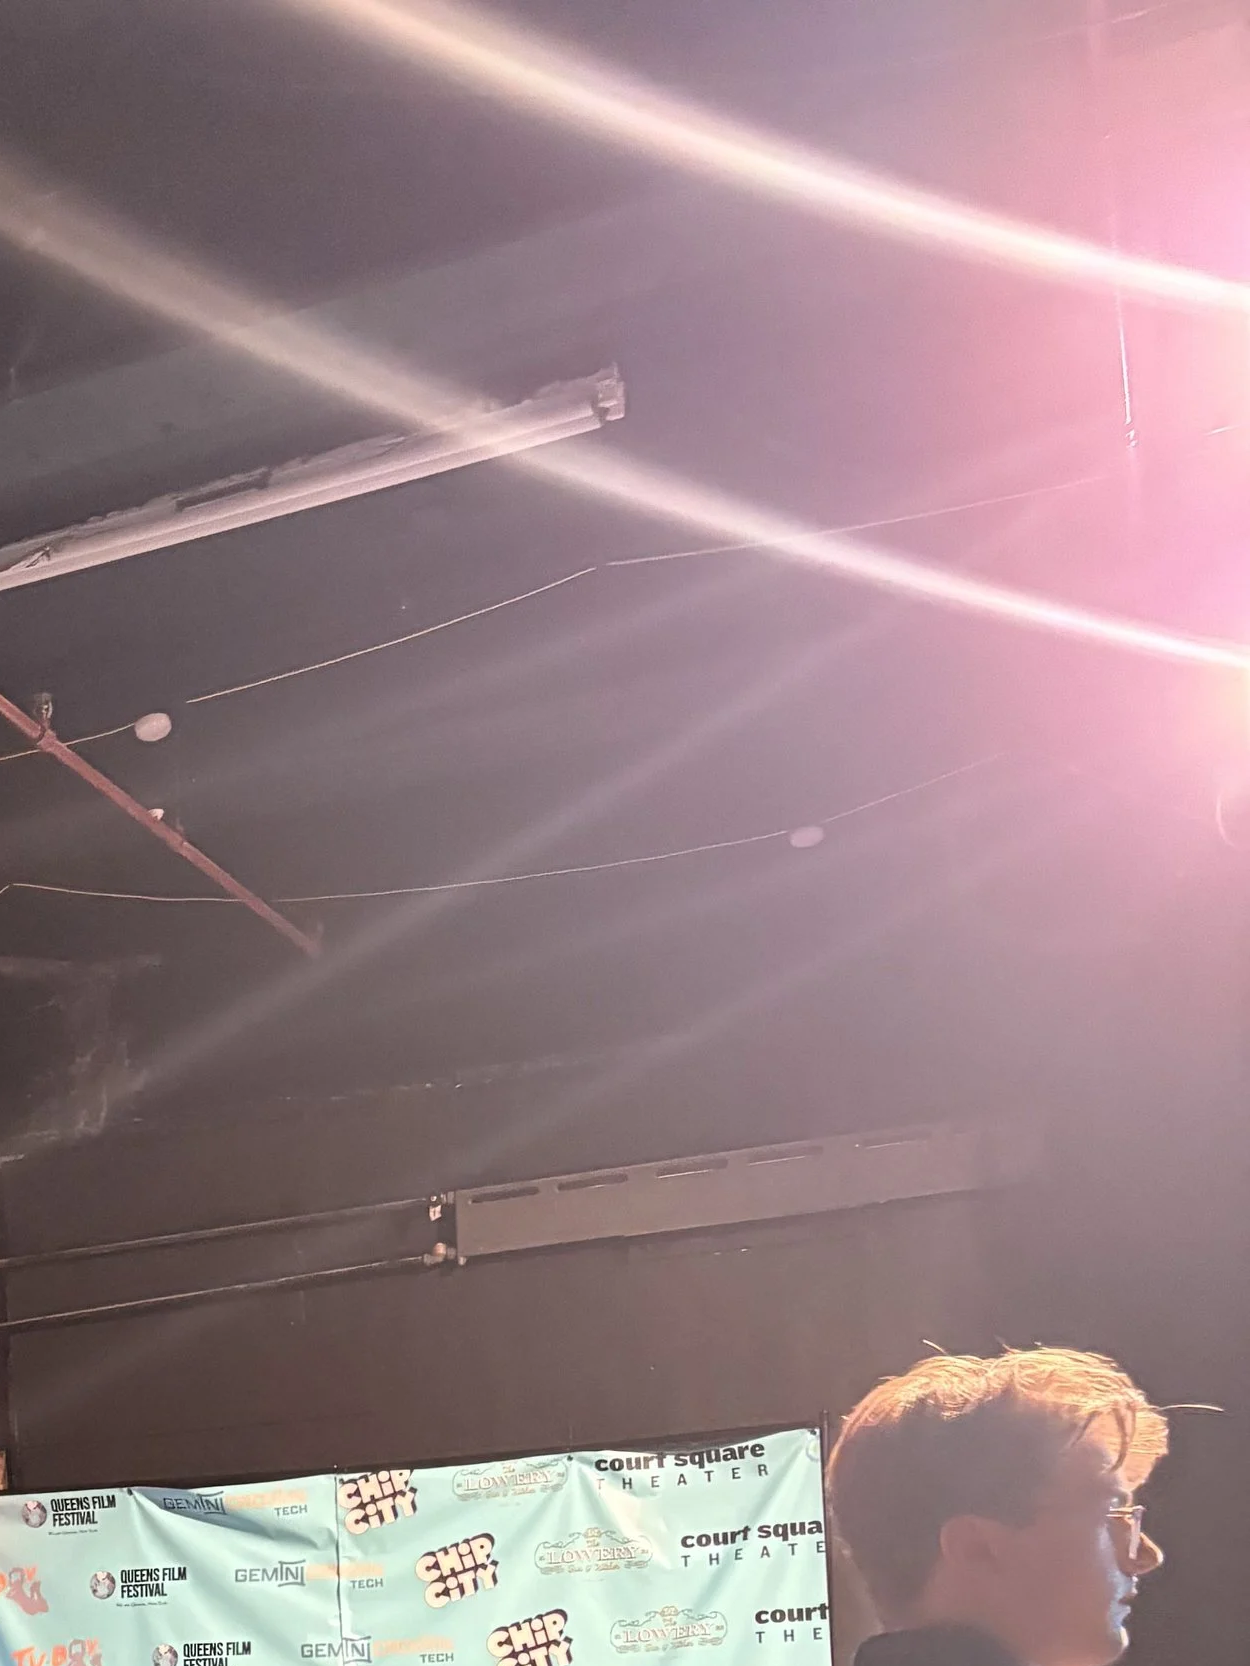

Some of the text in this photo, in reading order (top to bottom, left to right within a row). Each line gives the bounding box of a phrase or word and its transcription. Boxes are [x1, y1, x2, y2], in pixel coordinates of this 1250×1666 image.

[595, 1443, 765, 1472] court square
[464, 1469, 555, 1491] LOWERY
[597, 1464, 769, 1490] THEATER
[50, 1494, 116, 1512] QUEENS FILM
[163, 1491, 227, 1515] GEMINI
[274, 1505, 308, 1517] TECH
[53, 1511, 98, 1527] FESTIVAL
[680, 1520, 823, 1548] court squa
[546, 1546, 639, 1564] LOWERY
[681, 1541, 826, 1567] THEATE
[120, 1567, 187, 1584] QUEENS FILM
[235, 1559, 306, 1587] GEMINI
[351, 1578, 384, 1589] TECH
[121, 1583, 167, 1599] FESTIVAL
[755, 1603, 829, 1624] court
[623, 1622, 713, 1643] LOWERY
[183, 1641, 251, 1658] QUEENS FILM
[301, 1636, 372, 1663] GEMINI
[420, 1653, 454, 1664] TECH
